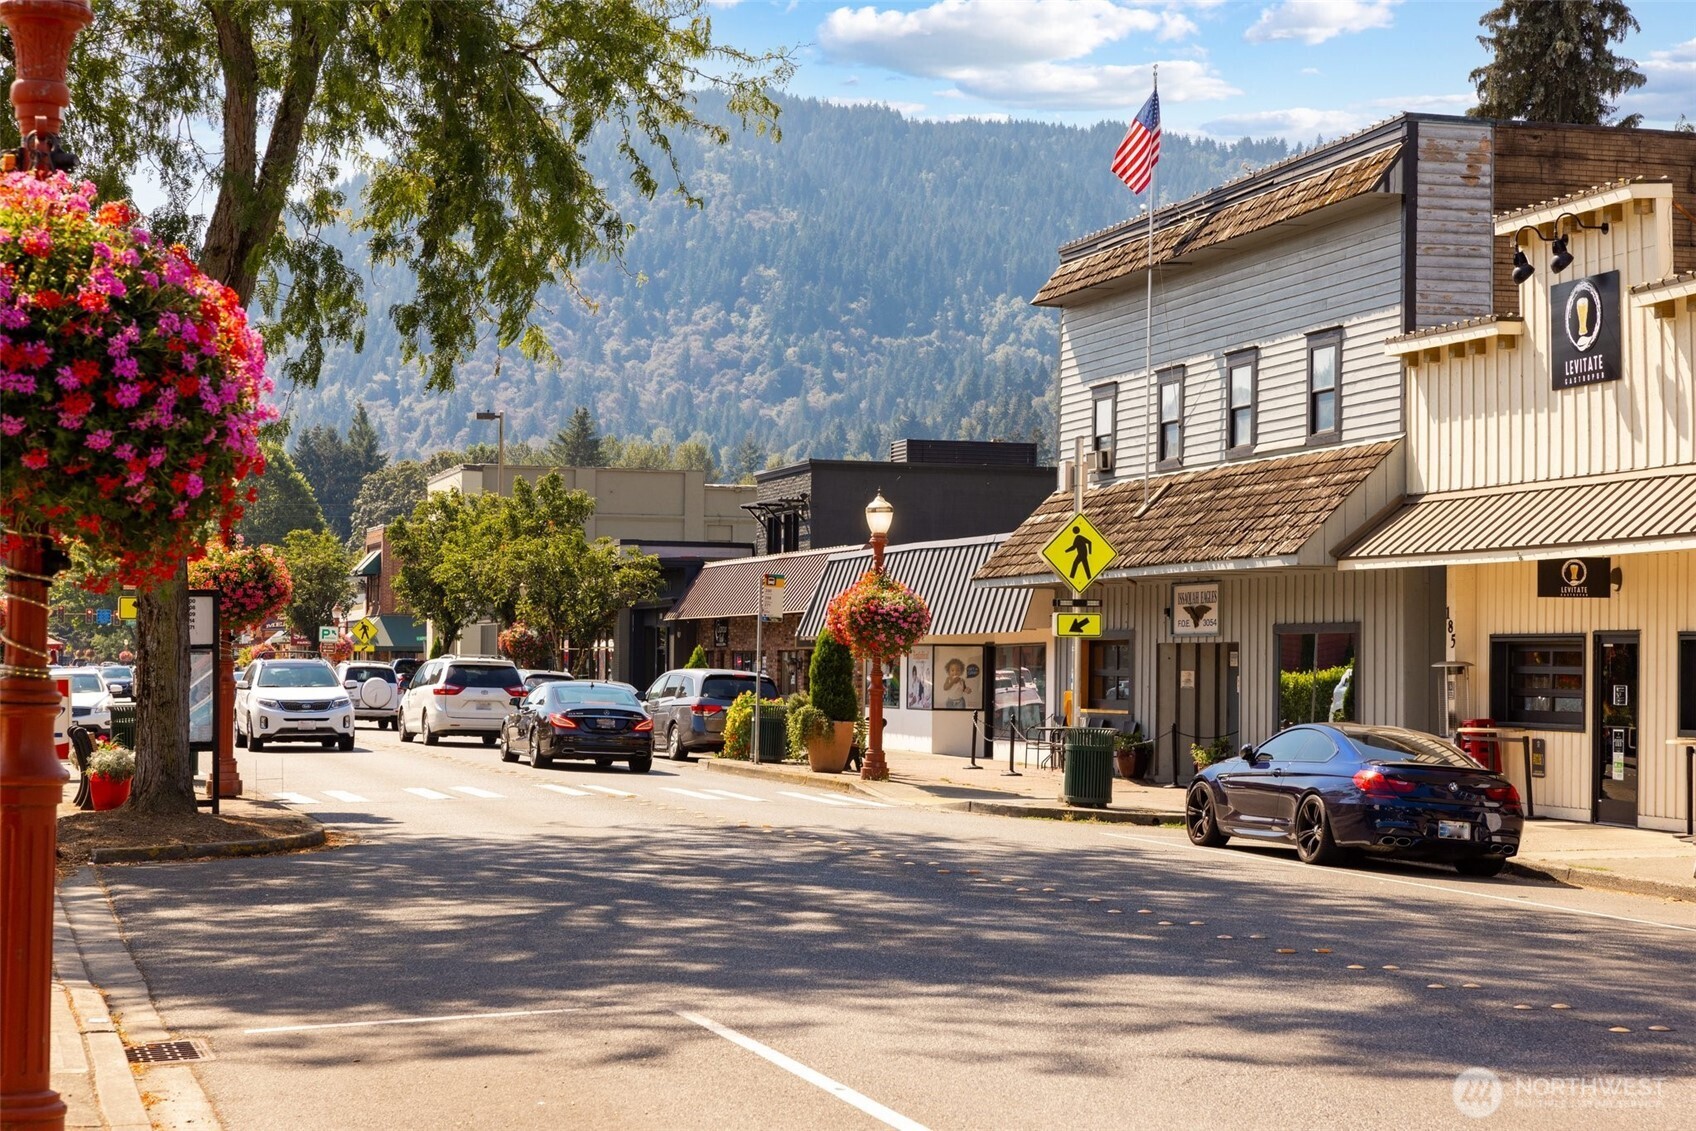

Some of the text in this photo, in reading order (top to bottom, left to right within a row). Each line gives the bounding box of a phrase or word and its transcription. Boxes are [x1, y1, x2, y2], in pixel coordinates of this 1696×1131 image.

[1565, 354, 1603, 376] LEVITATE
[1177, 590, 1218, 605] ISSAQUAH EAGLES
[1202, 618, 1217, 627] 3054
[1446, 606, 1456, 649] 185
[322, 629, 331, 639] P
